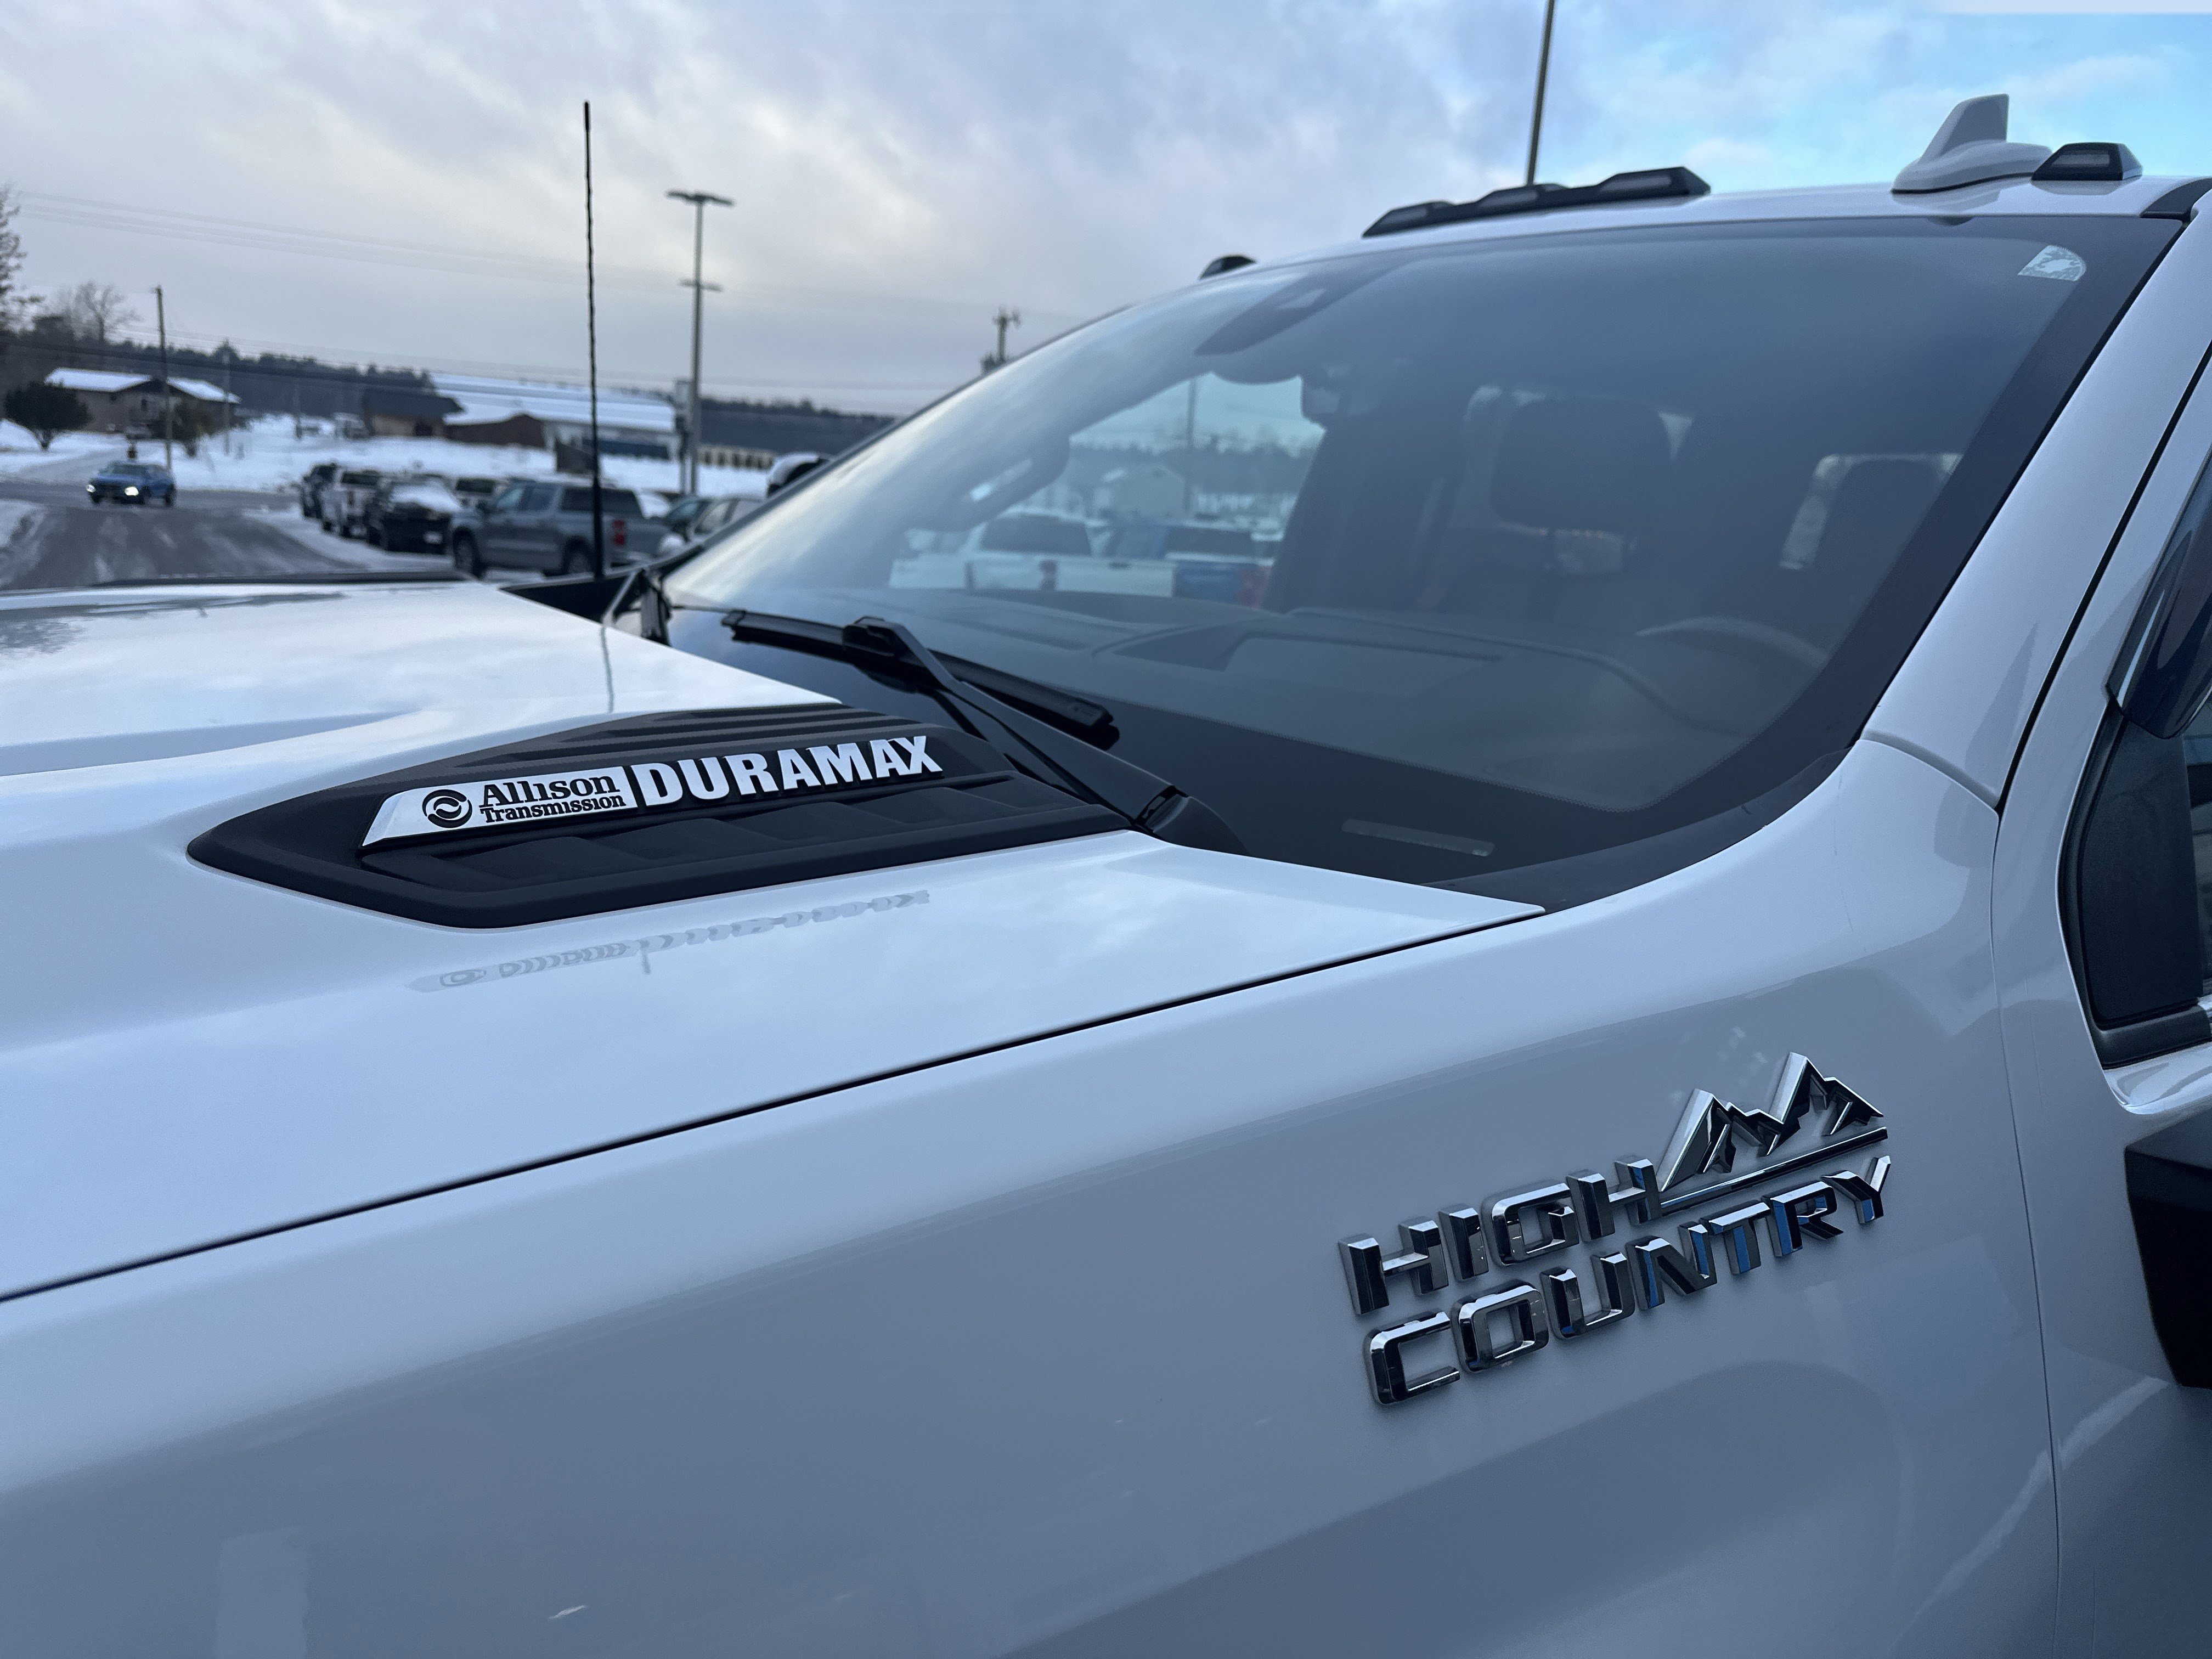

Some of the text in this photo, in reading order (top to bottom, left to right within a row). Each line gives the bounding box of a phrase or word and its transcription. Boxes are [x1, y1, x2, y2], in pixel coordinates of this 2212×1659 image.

[479, 775, 620, 808] Allison
[631, 735, 943, 806] DURAMAX
[480, 795, 627, 823] Transmission
[1339, 1156, 1659, 1314] HIGH
[1364, 1155, 1891, 1405] COUNTRY
